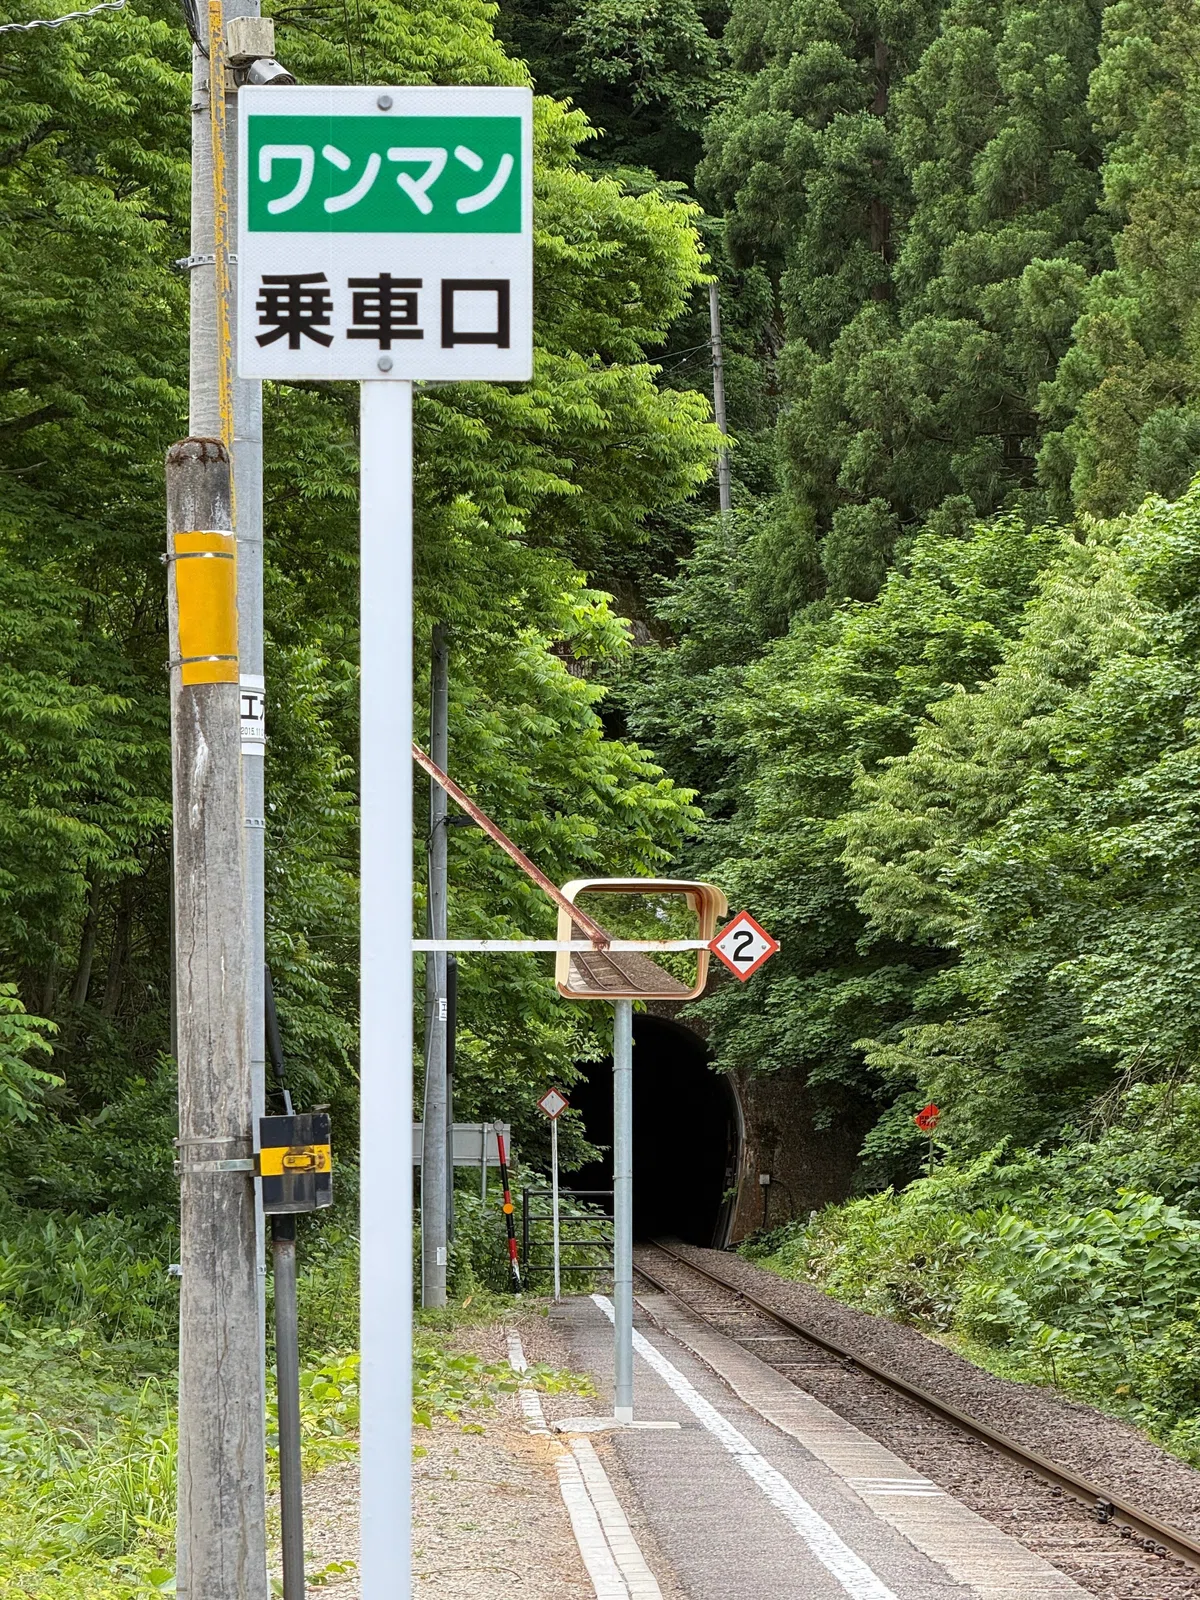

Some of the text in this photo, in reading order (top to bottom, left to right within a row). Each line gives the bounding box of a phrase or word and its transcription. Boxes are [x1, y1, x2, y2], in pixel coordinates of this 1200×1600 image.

[259, 144, 514, 215] ワンマン
[255, 272, 511, 350] 乗車口
[733, 930, 754, 962] 2
